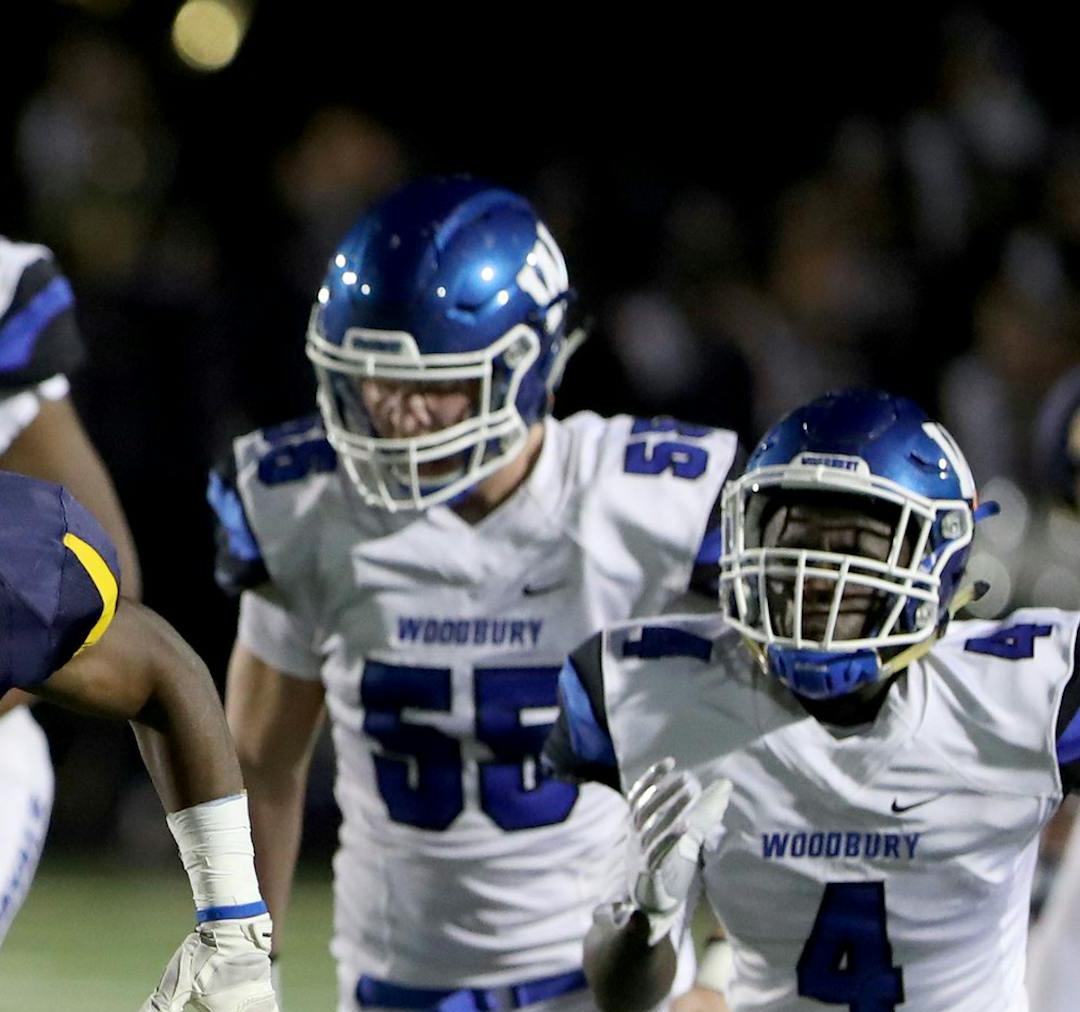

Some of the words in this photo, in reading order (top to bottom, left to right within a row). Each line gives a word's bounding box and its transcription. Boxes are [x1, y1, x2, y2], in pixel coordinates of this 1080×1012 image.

[397, 617, 543, 645] WOODBURY
[964, 623, 1053, 661] 4
[360, 659, 581, 833] 55
[762, 831, 921, 860] WOODBURY
